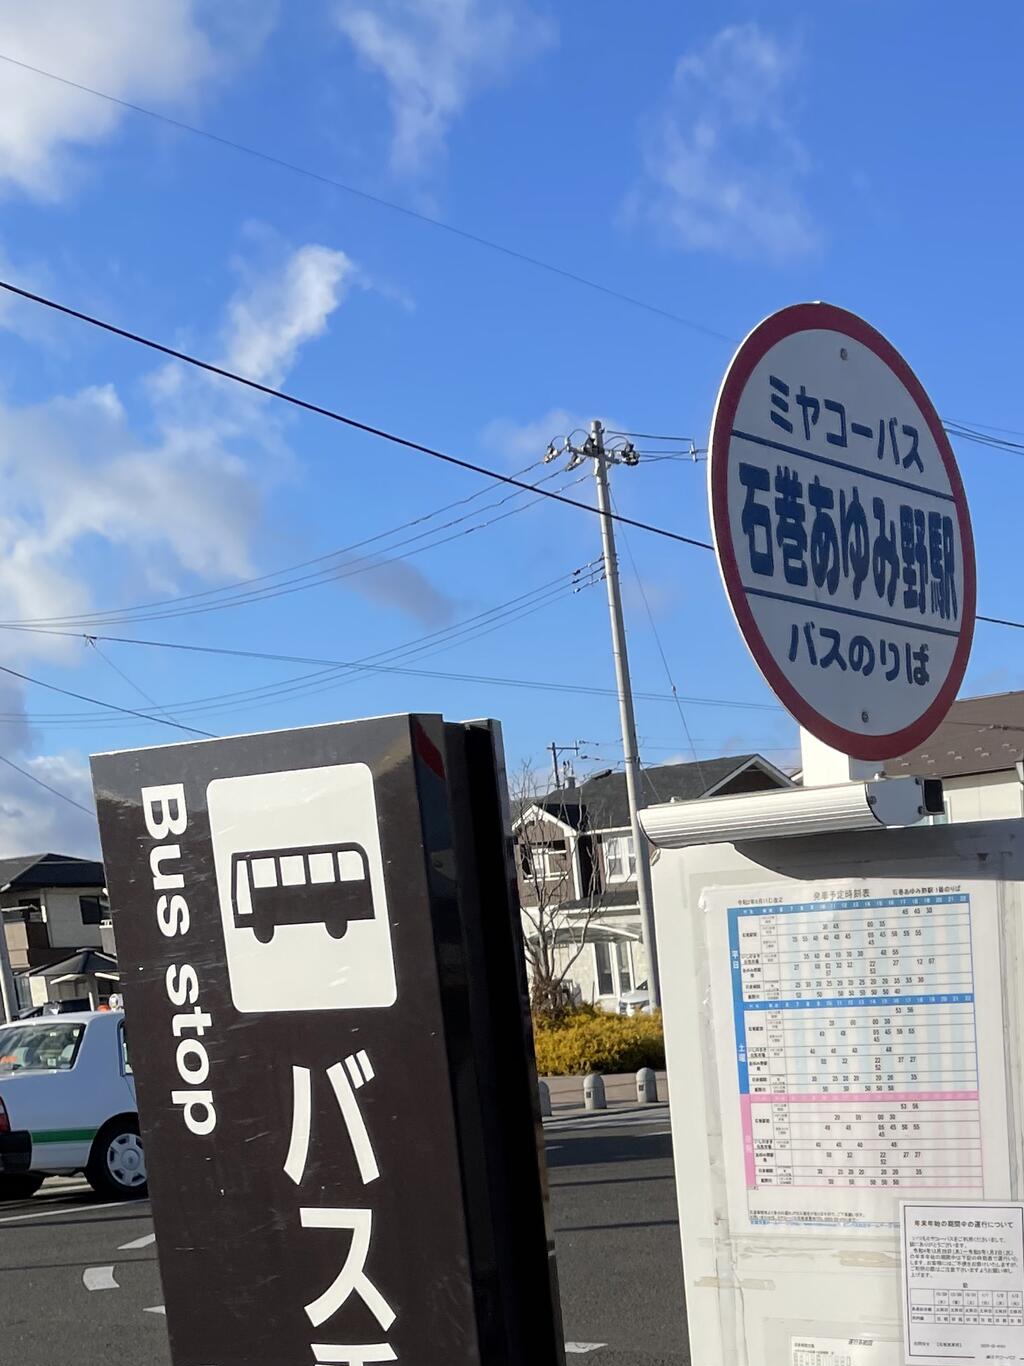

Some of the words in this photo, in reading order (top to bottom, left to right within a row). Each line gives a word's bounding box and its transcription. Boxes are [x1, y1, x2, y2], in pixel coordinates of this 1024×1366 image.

[769, 374, 924, 474] ミヤコーバス
[739, 461, 958, 620] 石巻あゆみ野駅
[789, 620, 930, 687] バスのりば
[141, 783, 190, 938] Bus
[168, 962, 217, 1136] stop
[914, 1220, 1014, 1228] 年末年始の期間中の運行について
